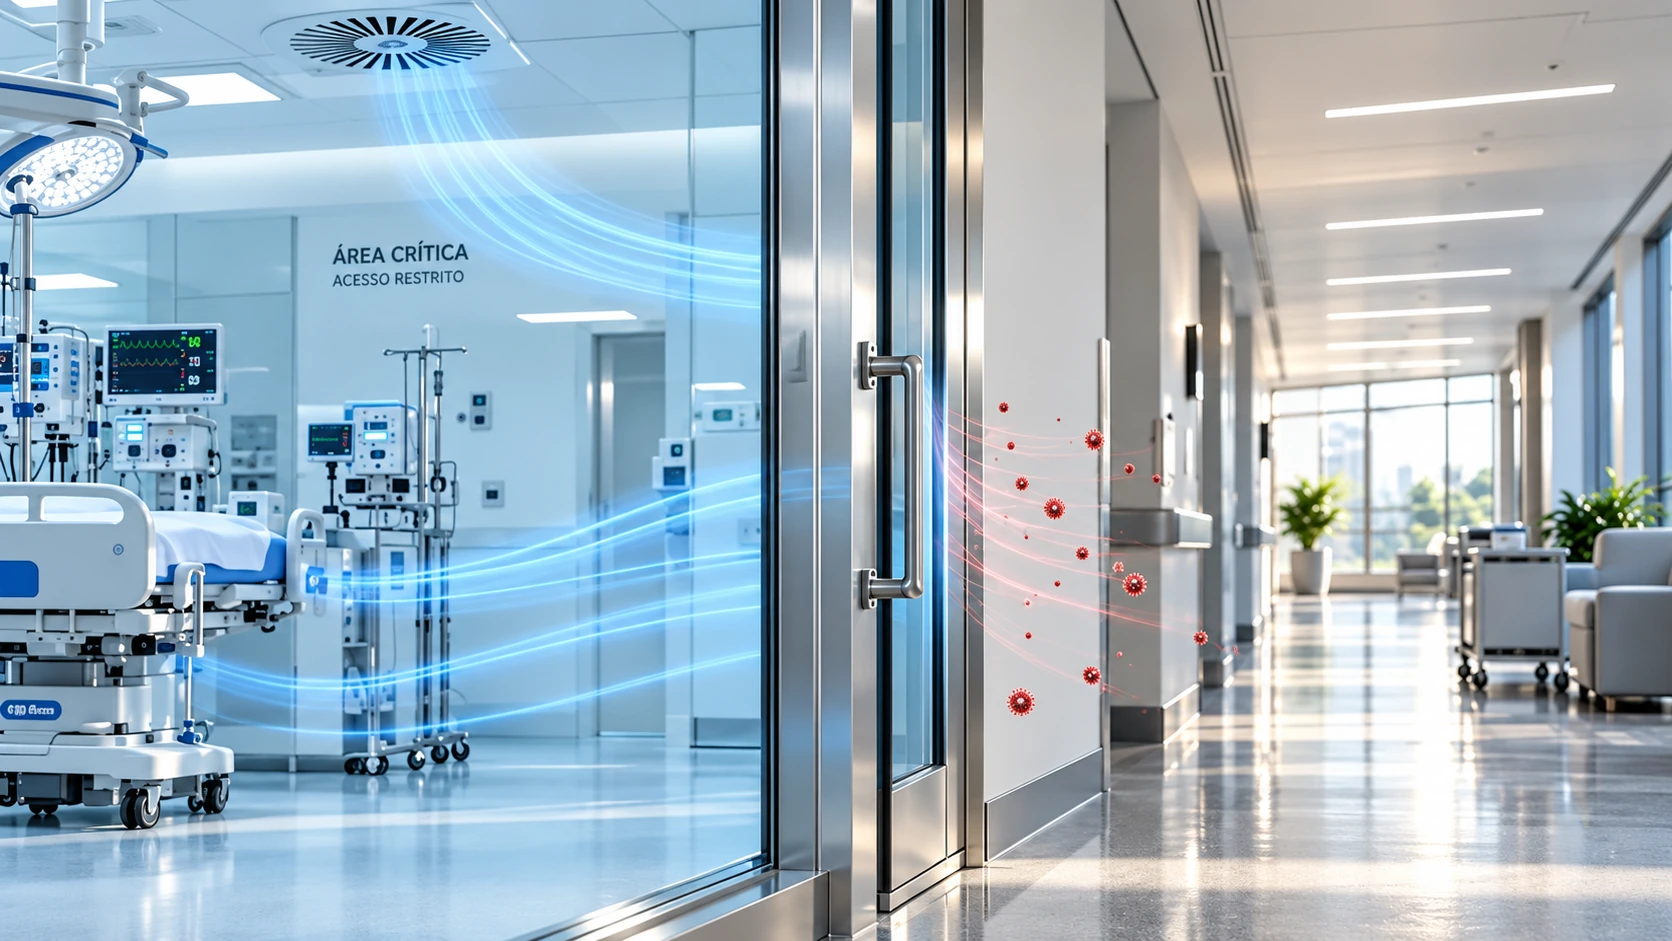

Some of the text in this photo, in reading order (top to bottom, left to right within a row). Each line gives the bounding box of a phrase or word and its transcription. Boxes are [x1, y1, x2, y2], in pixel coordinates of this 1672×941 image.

[332, 240, 469, 265] ÁREA CRÍTICA
[332, 270, 464, 287] ACESSO RESTRITO
